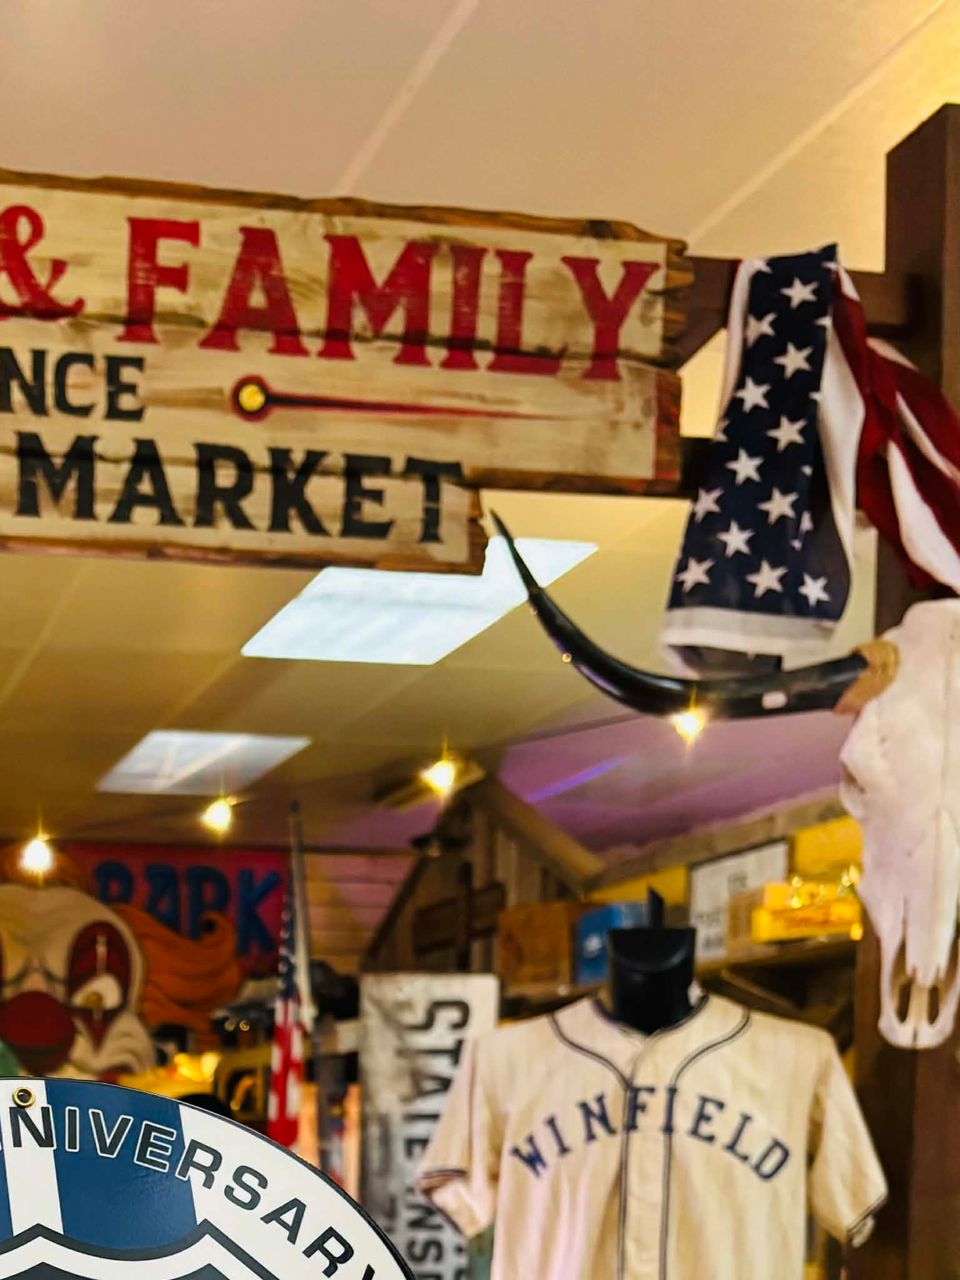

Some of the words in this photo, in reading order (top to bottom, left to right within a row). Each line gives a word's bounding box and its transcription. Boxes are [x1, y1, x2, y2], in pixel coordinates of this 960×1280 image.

[117, 215, 665, 382] FAMILY
[16, 429, 466, 545] MARKET
[510, 1085, 792, 1184] WINFIELD
